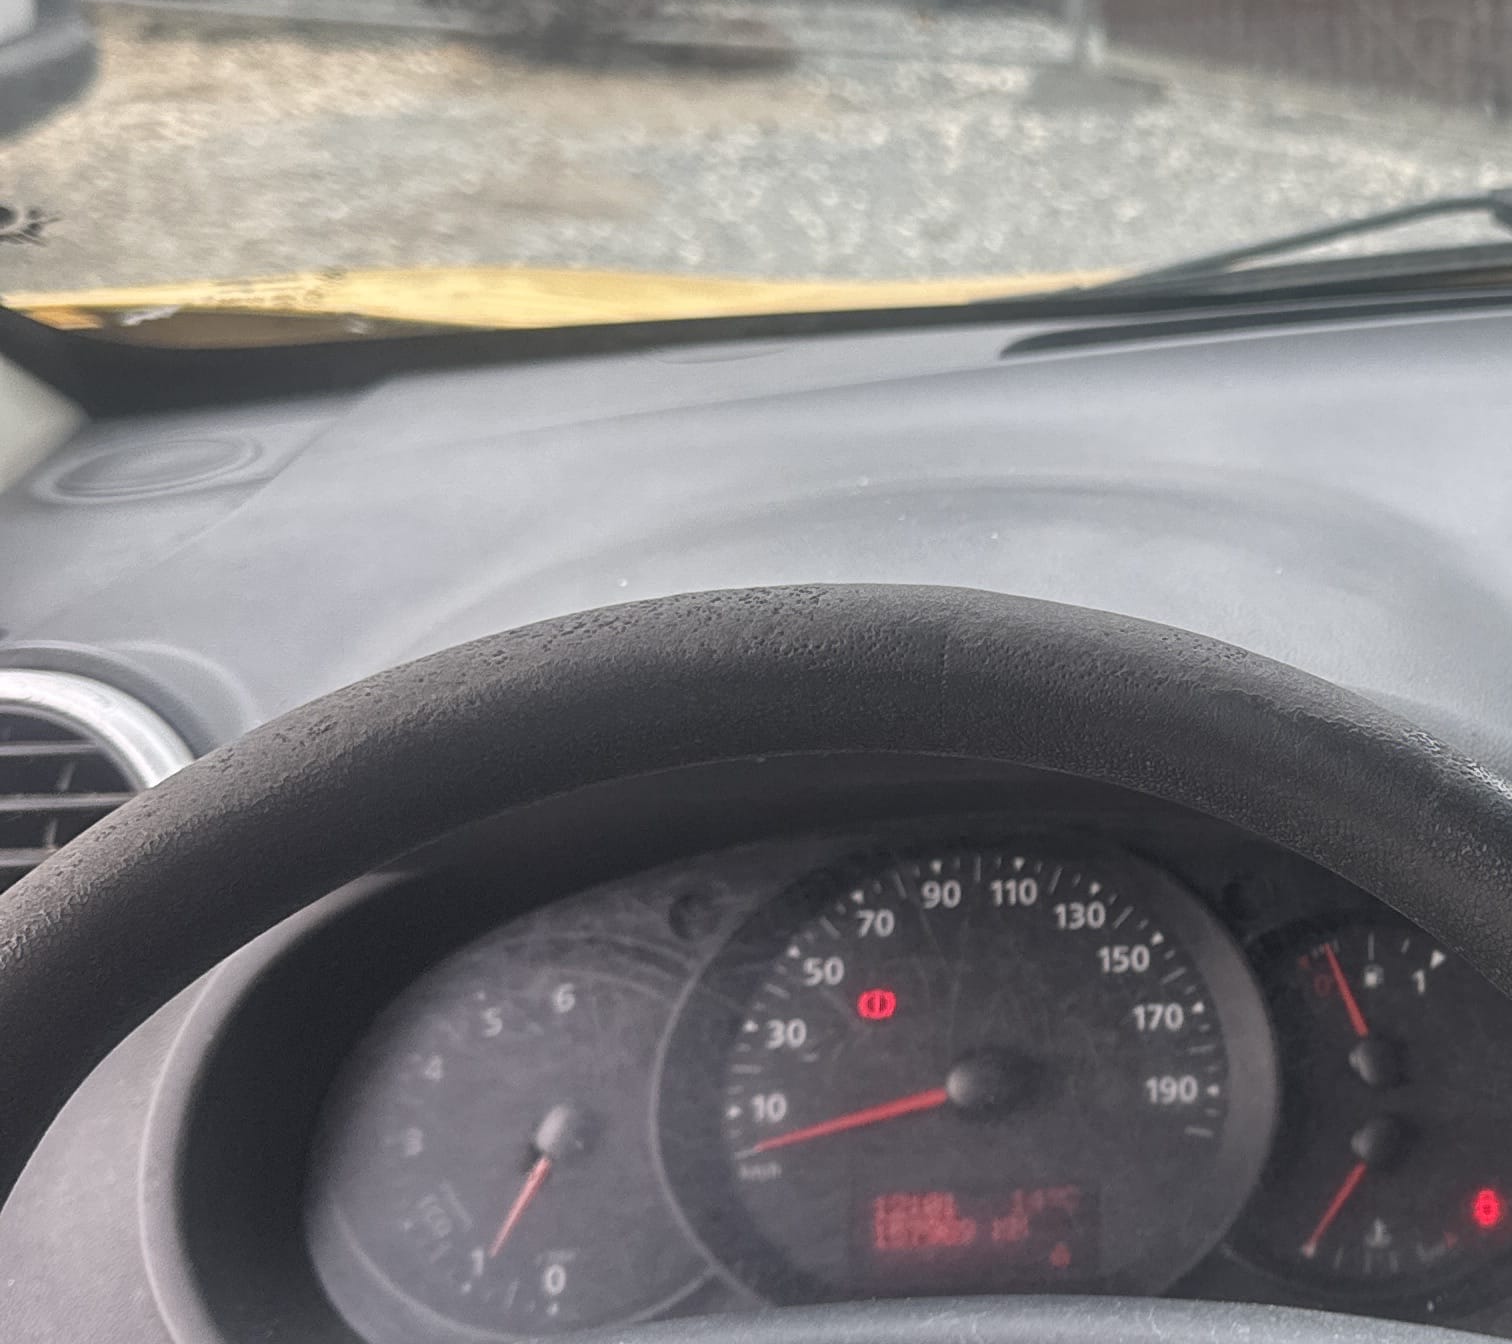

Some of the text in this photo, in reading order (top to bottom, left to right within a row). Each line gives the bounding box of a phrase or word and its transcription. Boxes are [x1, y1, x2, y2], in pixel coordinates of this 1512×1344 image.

[922, 880, 961, 909] 90
[991, 878, 1038, 906] 110
[856, 909, 895, 937] 70
[1054, 902, 1106, 930] 130
[803, 957, 845, 987] 50
[1098, 945, 1151, 973] 150
[1411, 969, 1426, 994] 1
[554, 982, 575, 1014] 6
[482, 1008, 503, 1038] 5
[1132, 1002, 1185, 1031] 170
[766, 1018, 807, 1049] 30
[1145, 1075, 1199, 1104] 190
[752, 1093, 787, 1123] 10
[543, 1264, 567, 1296] 0
